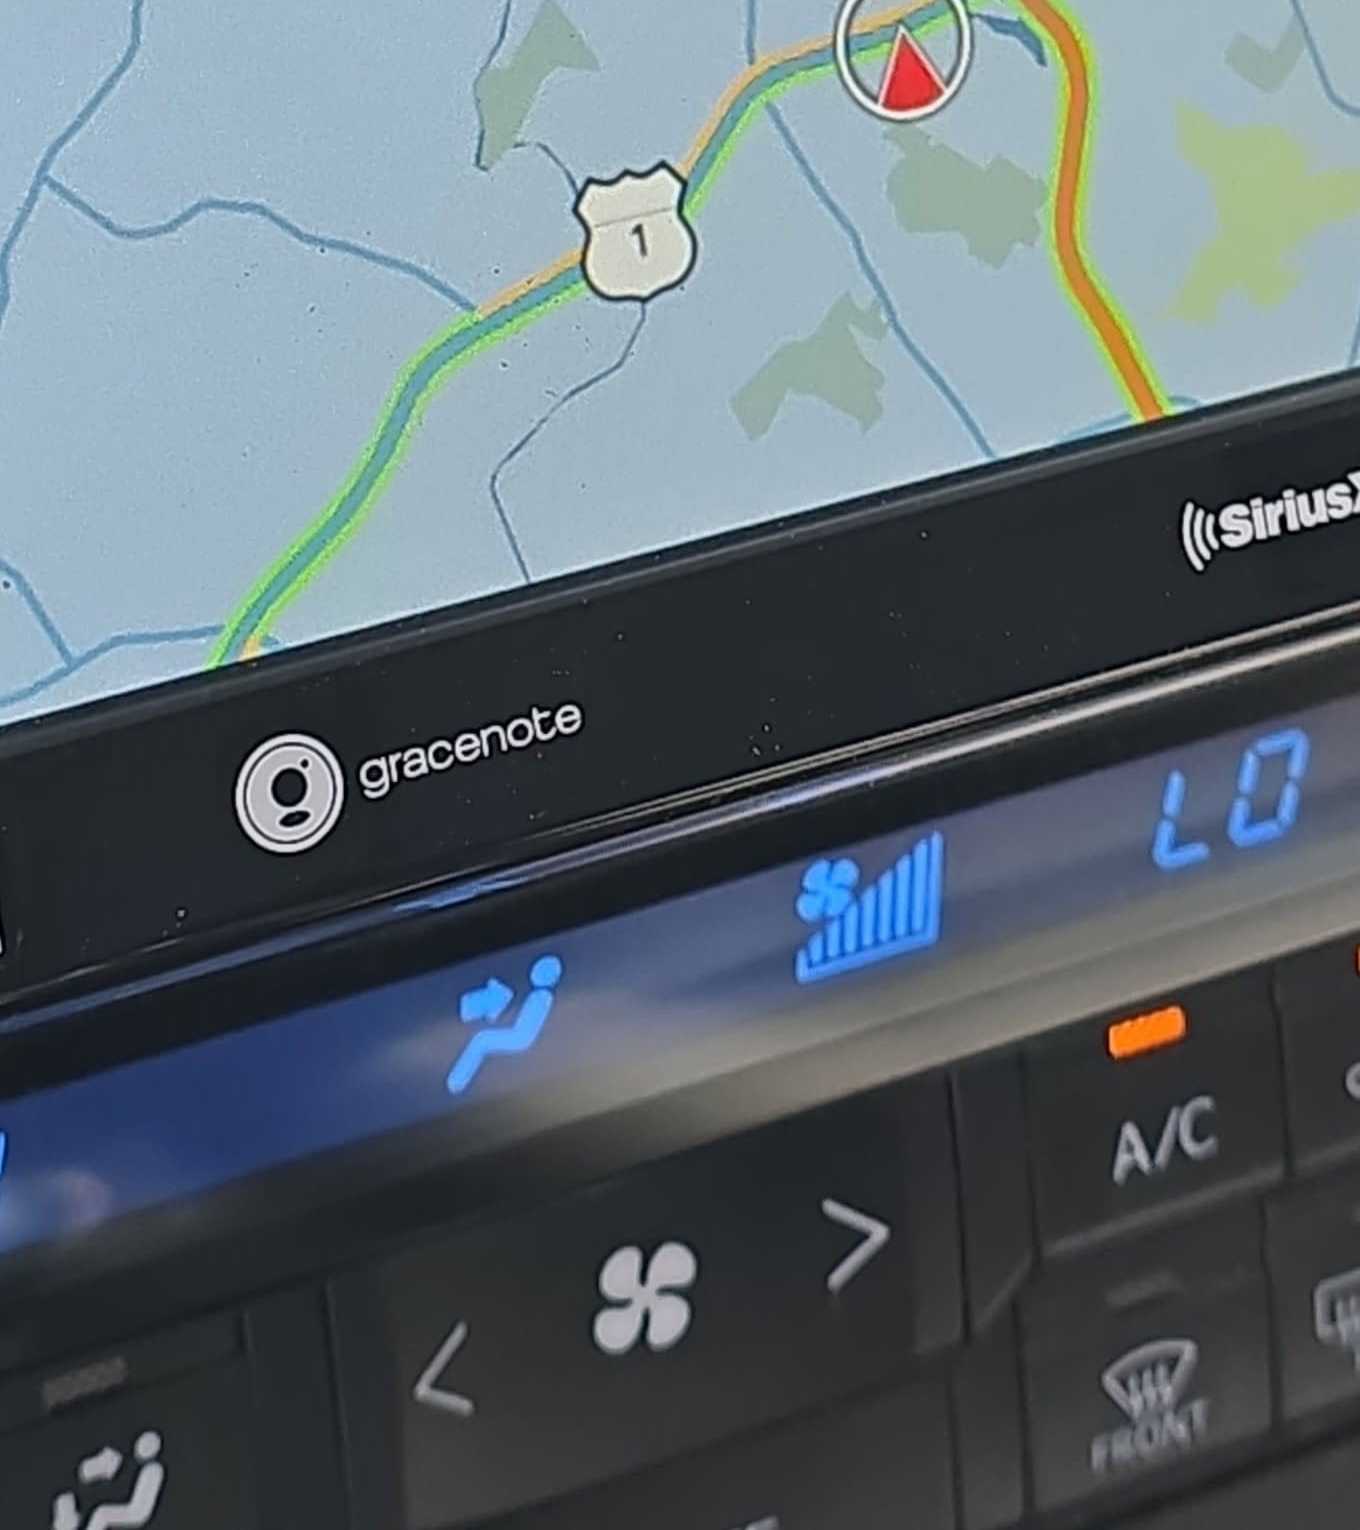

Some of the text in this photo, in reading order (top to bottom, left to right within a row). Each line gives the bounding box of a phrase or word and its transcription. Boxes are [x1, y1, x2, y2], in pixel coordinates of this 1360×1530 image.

[629, 222, 649, 258] 1
[358, 698, 583, 800] gracenote
[1113, 1095, 1220, 1184] A/C
[1090, 1398, 1210, 1474] FRONT
